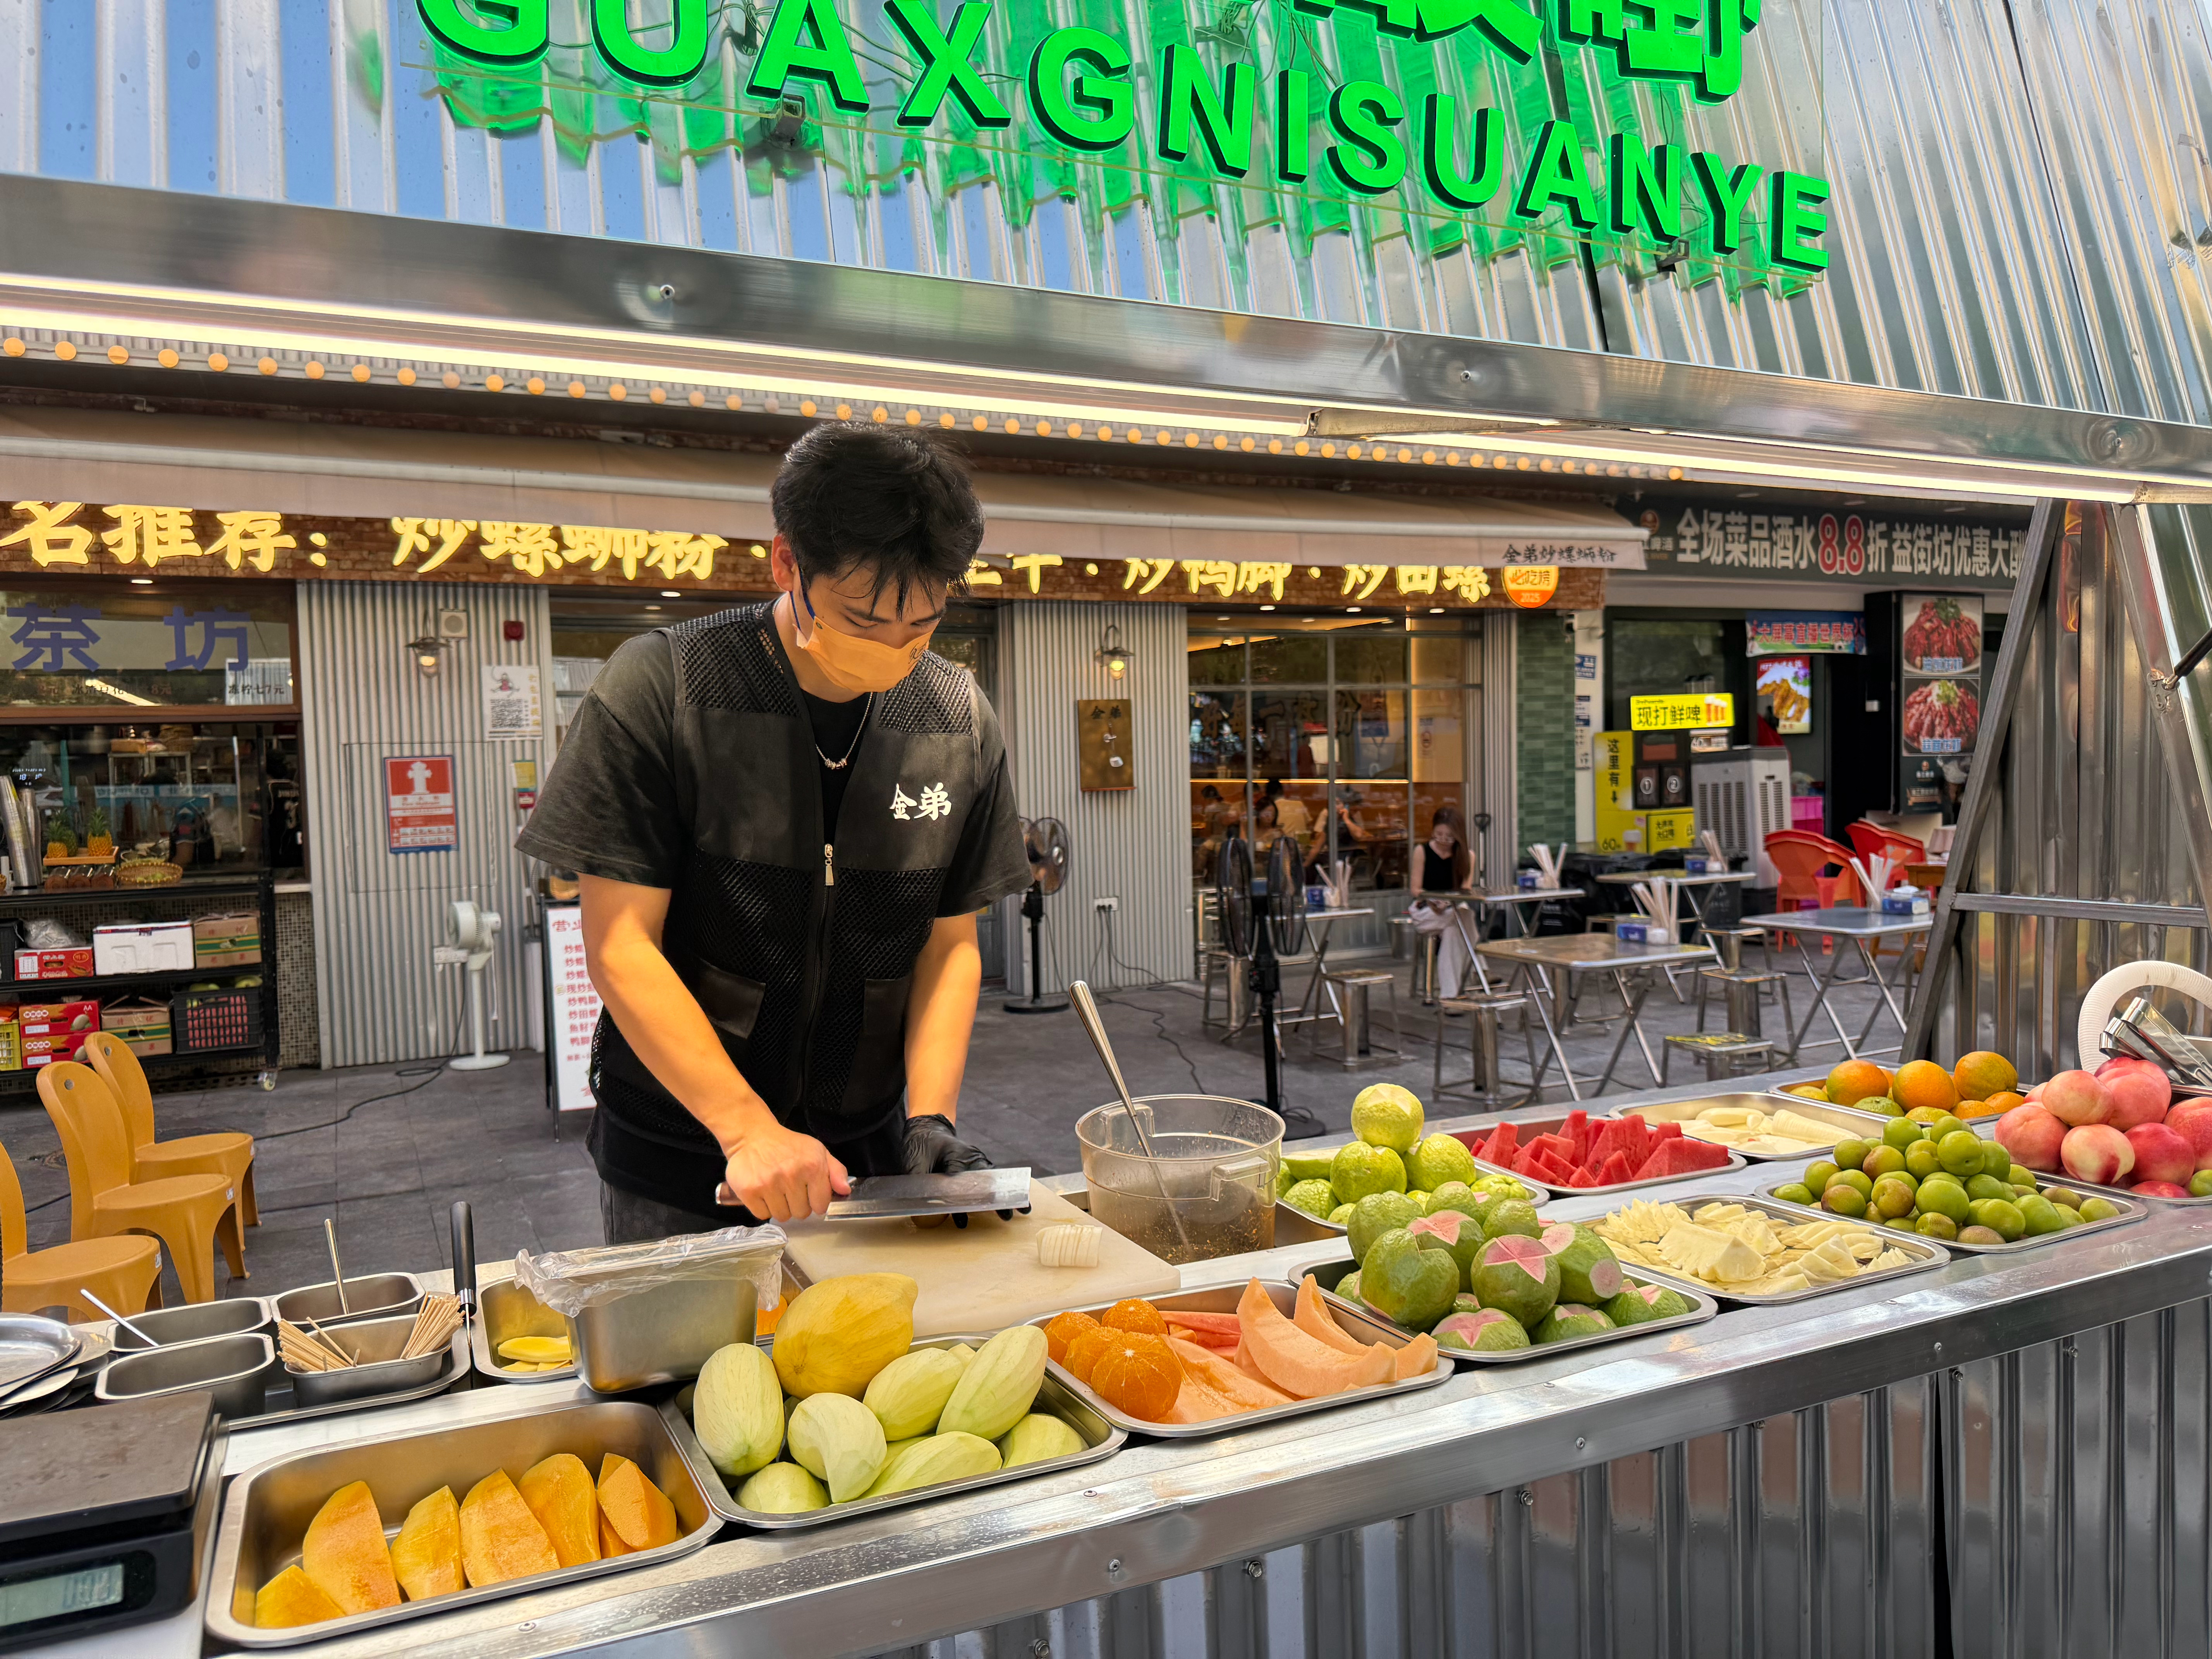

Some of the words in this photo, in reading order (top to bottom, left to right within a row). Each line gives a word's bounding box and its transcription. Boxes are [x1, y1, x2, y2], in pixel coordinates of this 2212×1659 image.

[1676, 508, 1888, 575] 全场菜品酒水8.8折
[1509, 569, 1550, 586] 必吃榜
[1520, 592, 1540, 603] 2025
[7, 602, 251, 673] 茶坊
[1636, 705, 1701, 727] 现打鲜啤
[890, 782, 952, 821] 金弟
